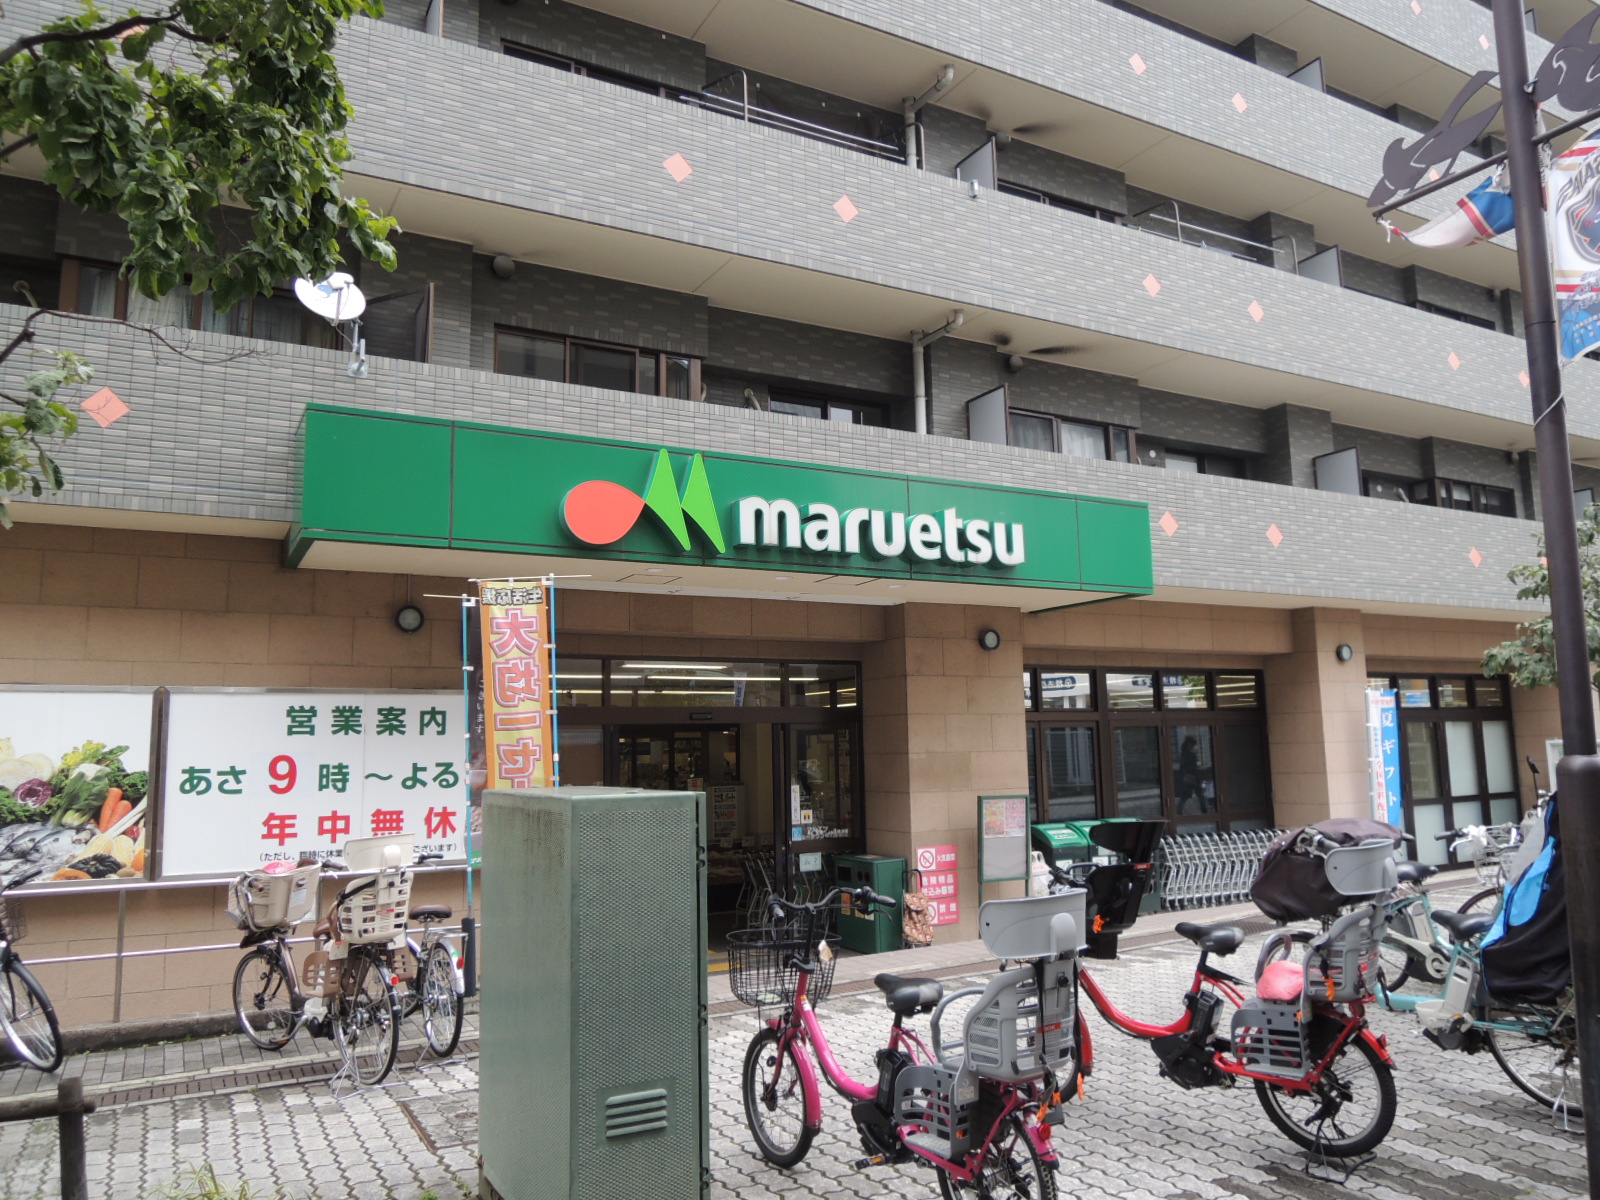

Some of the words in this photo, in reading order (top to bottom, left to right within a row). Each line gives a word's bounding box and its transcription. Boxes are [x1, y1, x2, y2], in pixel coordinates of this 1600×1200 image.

[733, 496, 1025, 566] maruetsu
[286, 705, 447, 736] 営業案内
[1381, 711, 1397, 806] 夏ギフト
[261, 806, 457, 846] 年中無休
